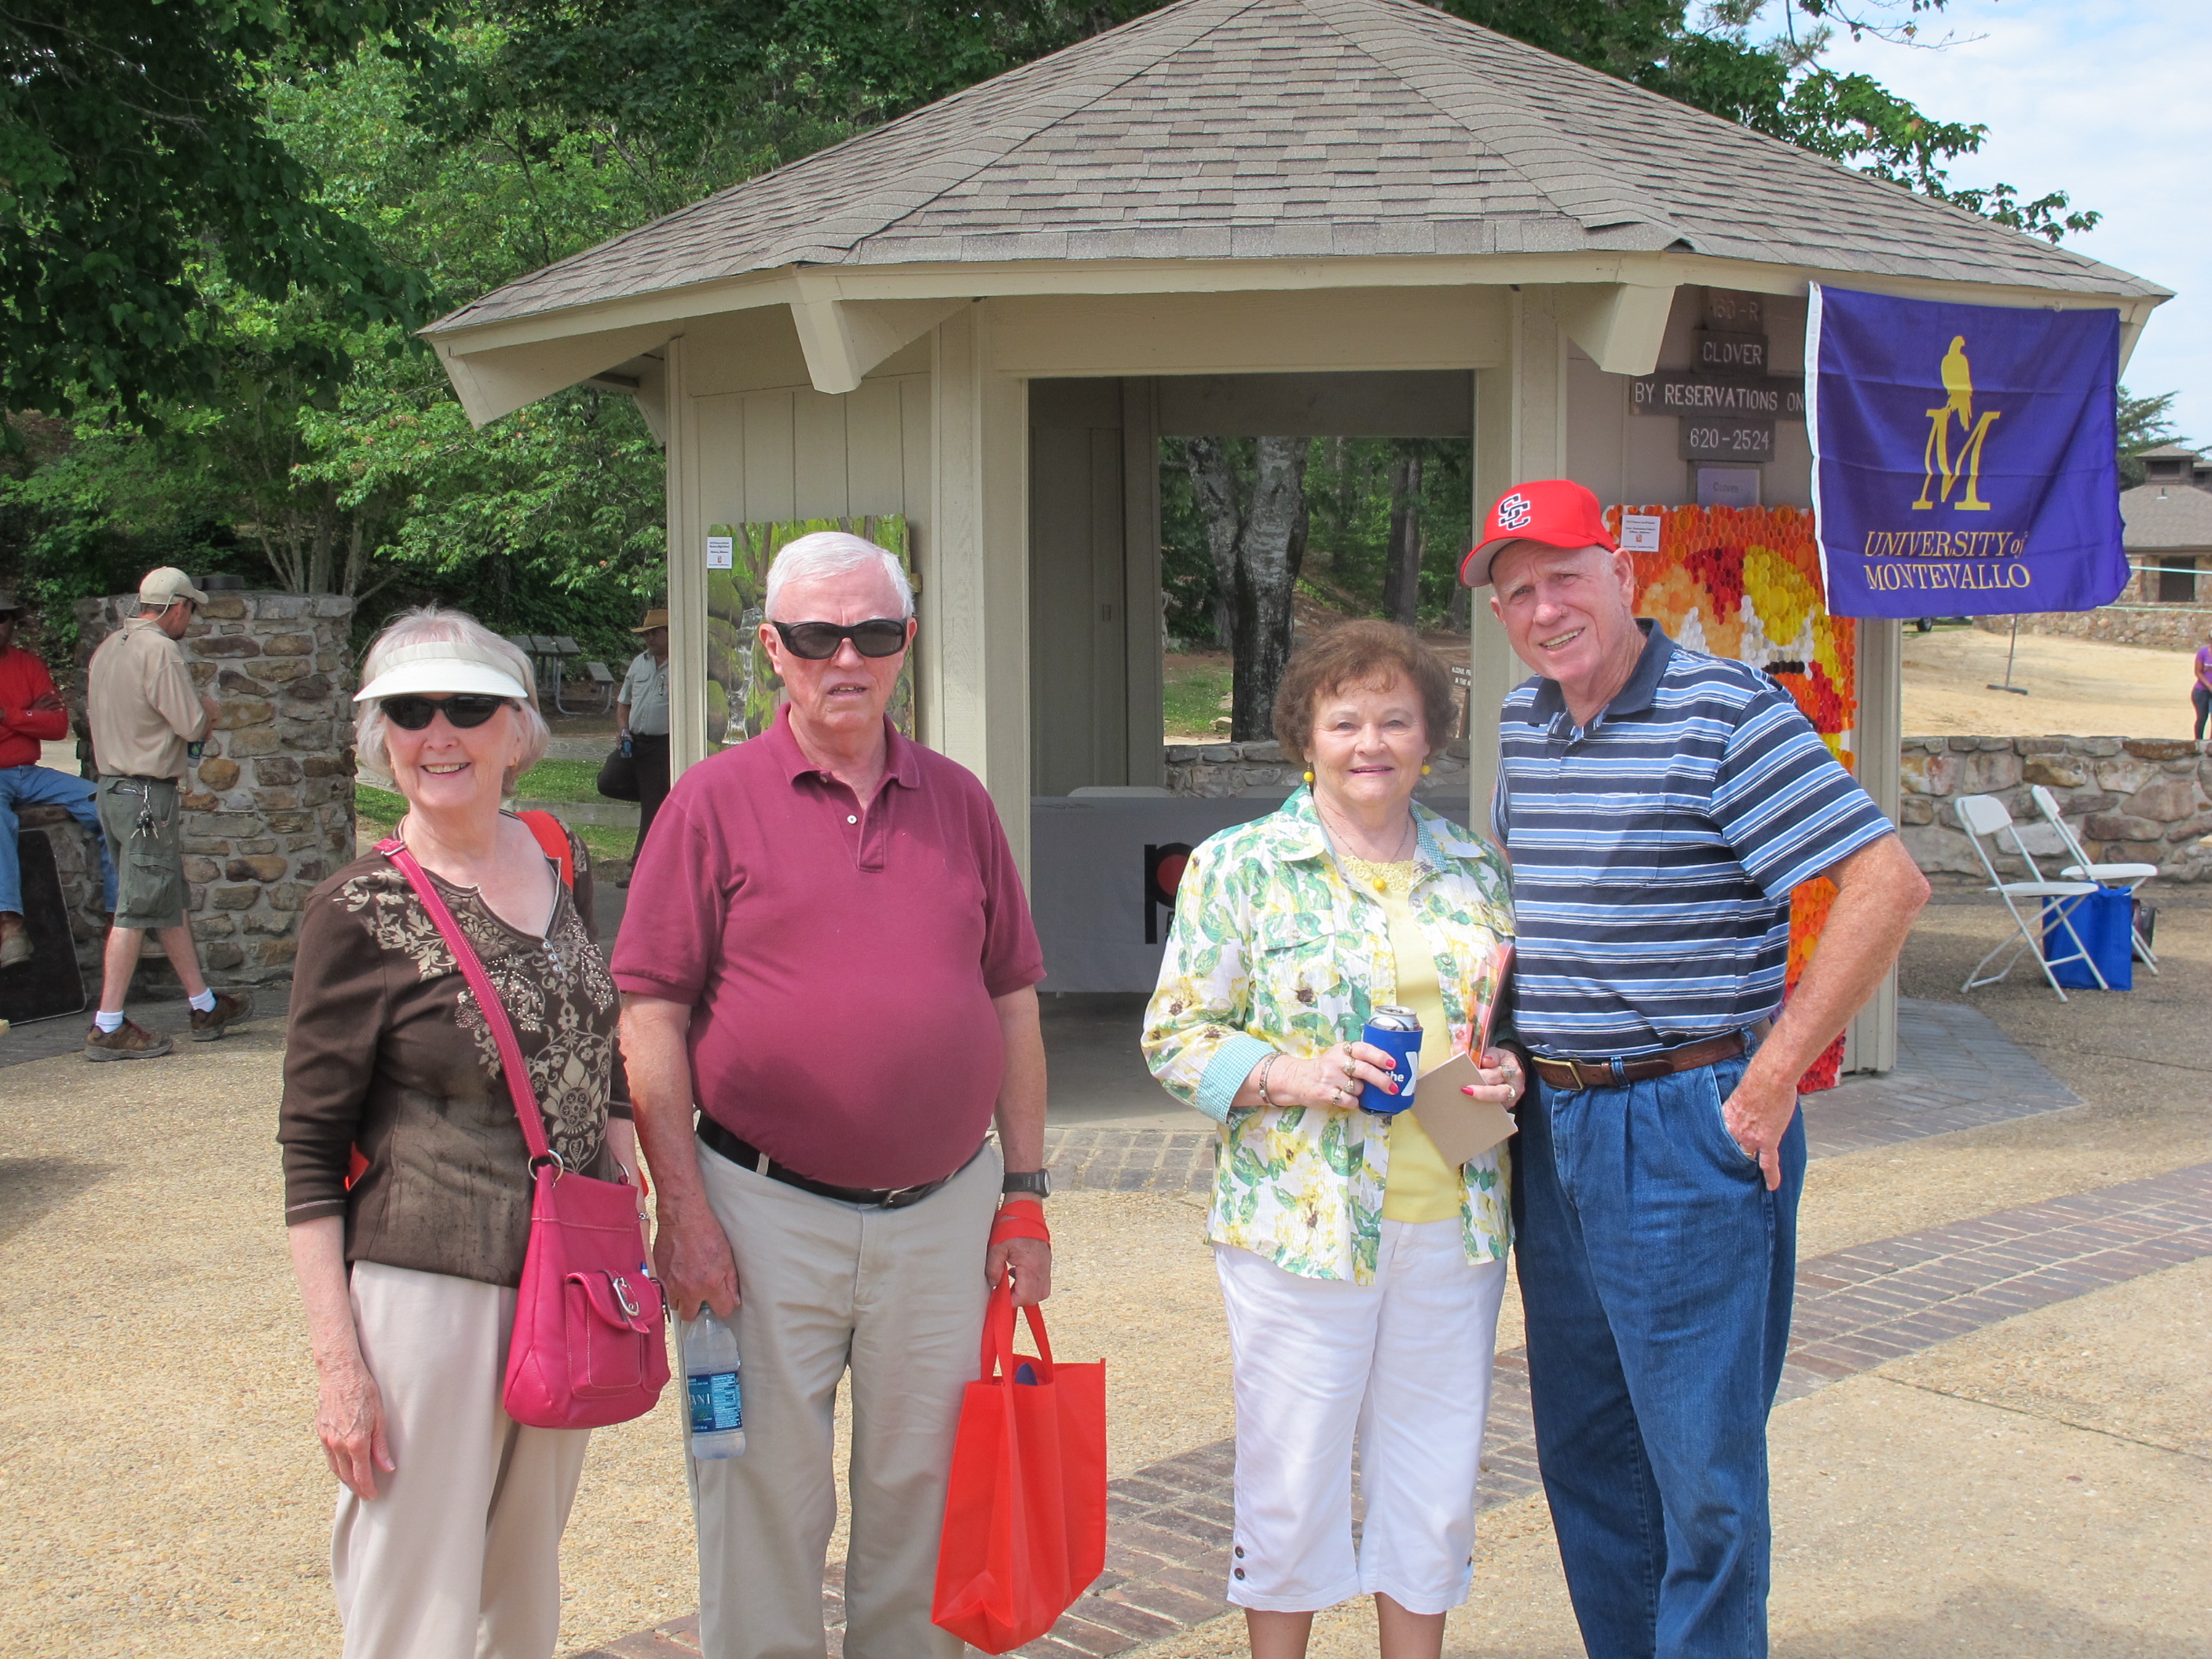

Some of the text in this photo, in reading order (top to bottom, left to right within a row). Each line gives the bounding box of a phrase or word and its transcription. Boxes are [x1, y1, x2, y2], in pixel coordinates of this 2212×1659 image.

[1703, 341, 1762, 365] CLOVER
[1635, 382, 1805, 412] BY RESERVATIONS ON
[1690, 428, 1769, 450] 620-2524
[1864, 530, 2027, 558] UNIVERSITY of
[1863, 563, 2031, 591] MONTEVALLO
[690, 1393, 711, 1407] ANI
